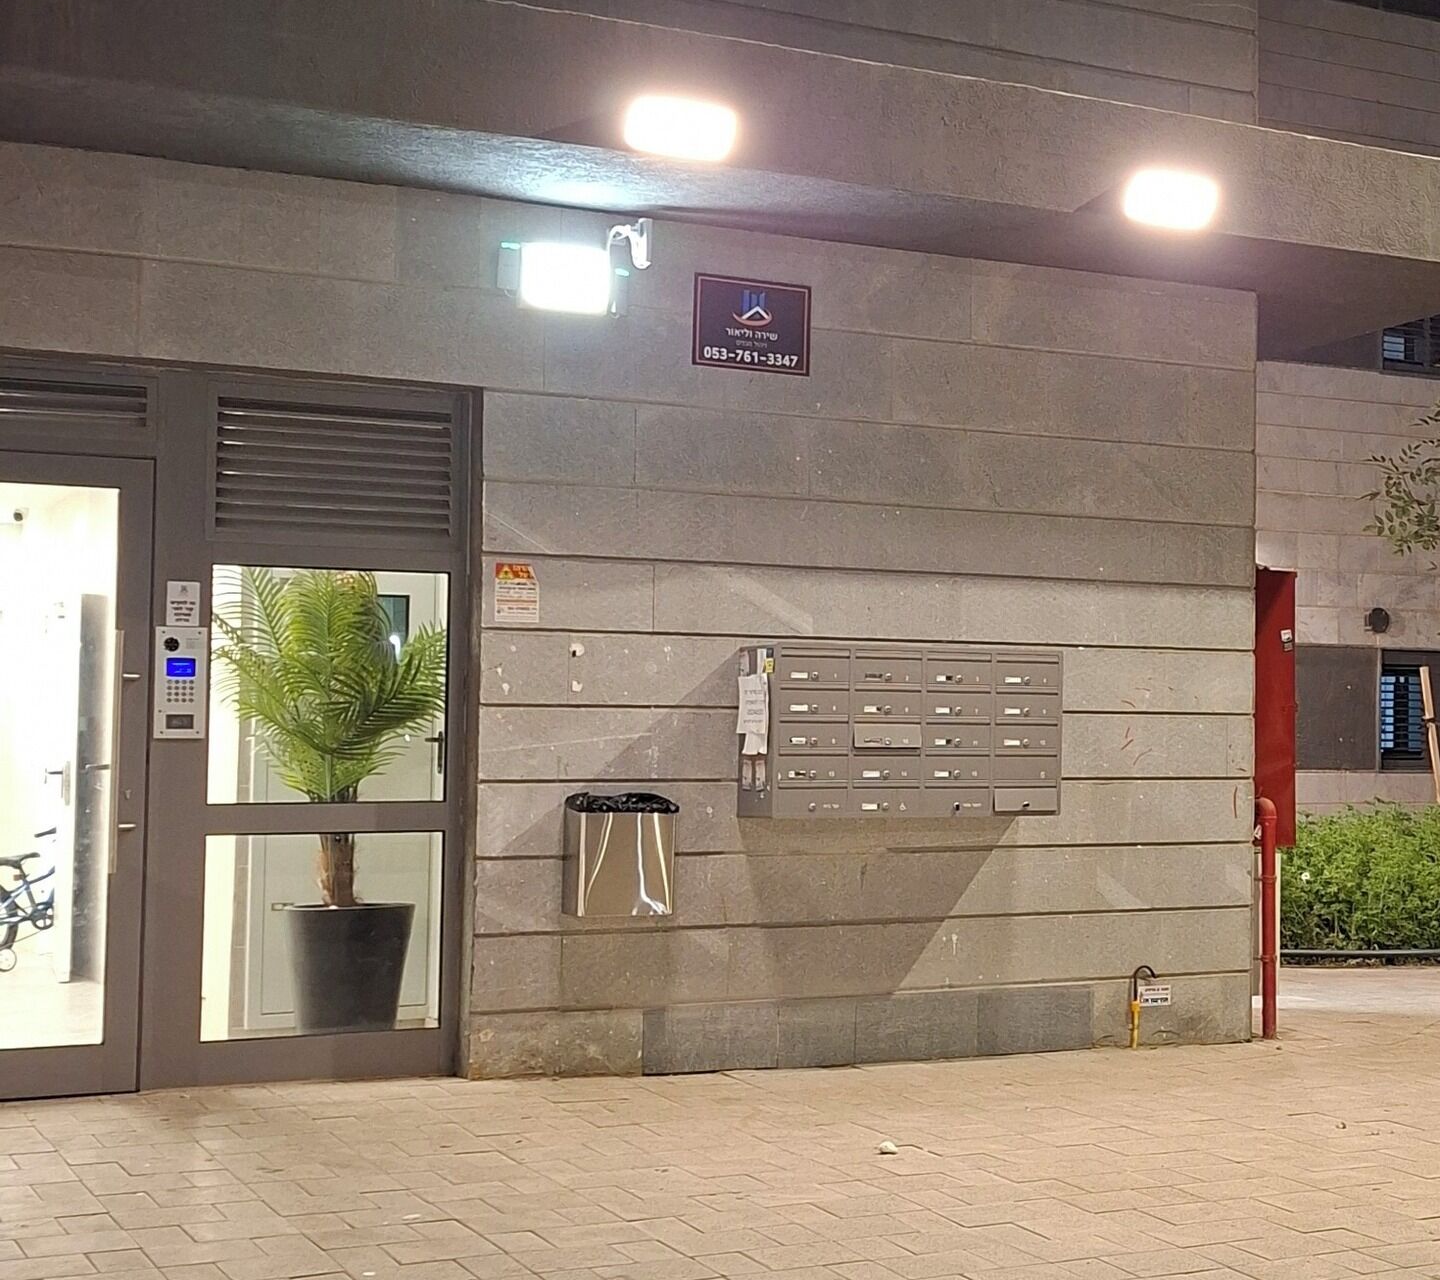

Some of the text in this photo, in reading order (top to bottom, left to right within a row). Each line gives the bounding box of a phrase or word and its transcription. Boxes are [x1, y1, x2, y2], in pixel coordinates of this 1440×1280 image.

[725, 327, 778, 342] שירה וליאור
[703, 346, 799, 368] 053-761-3347
